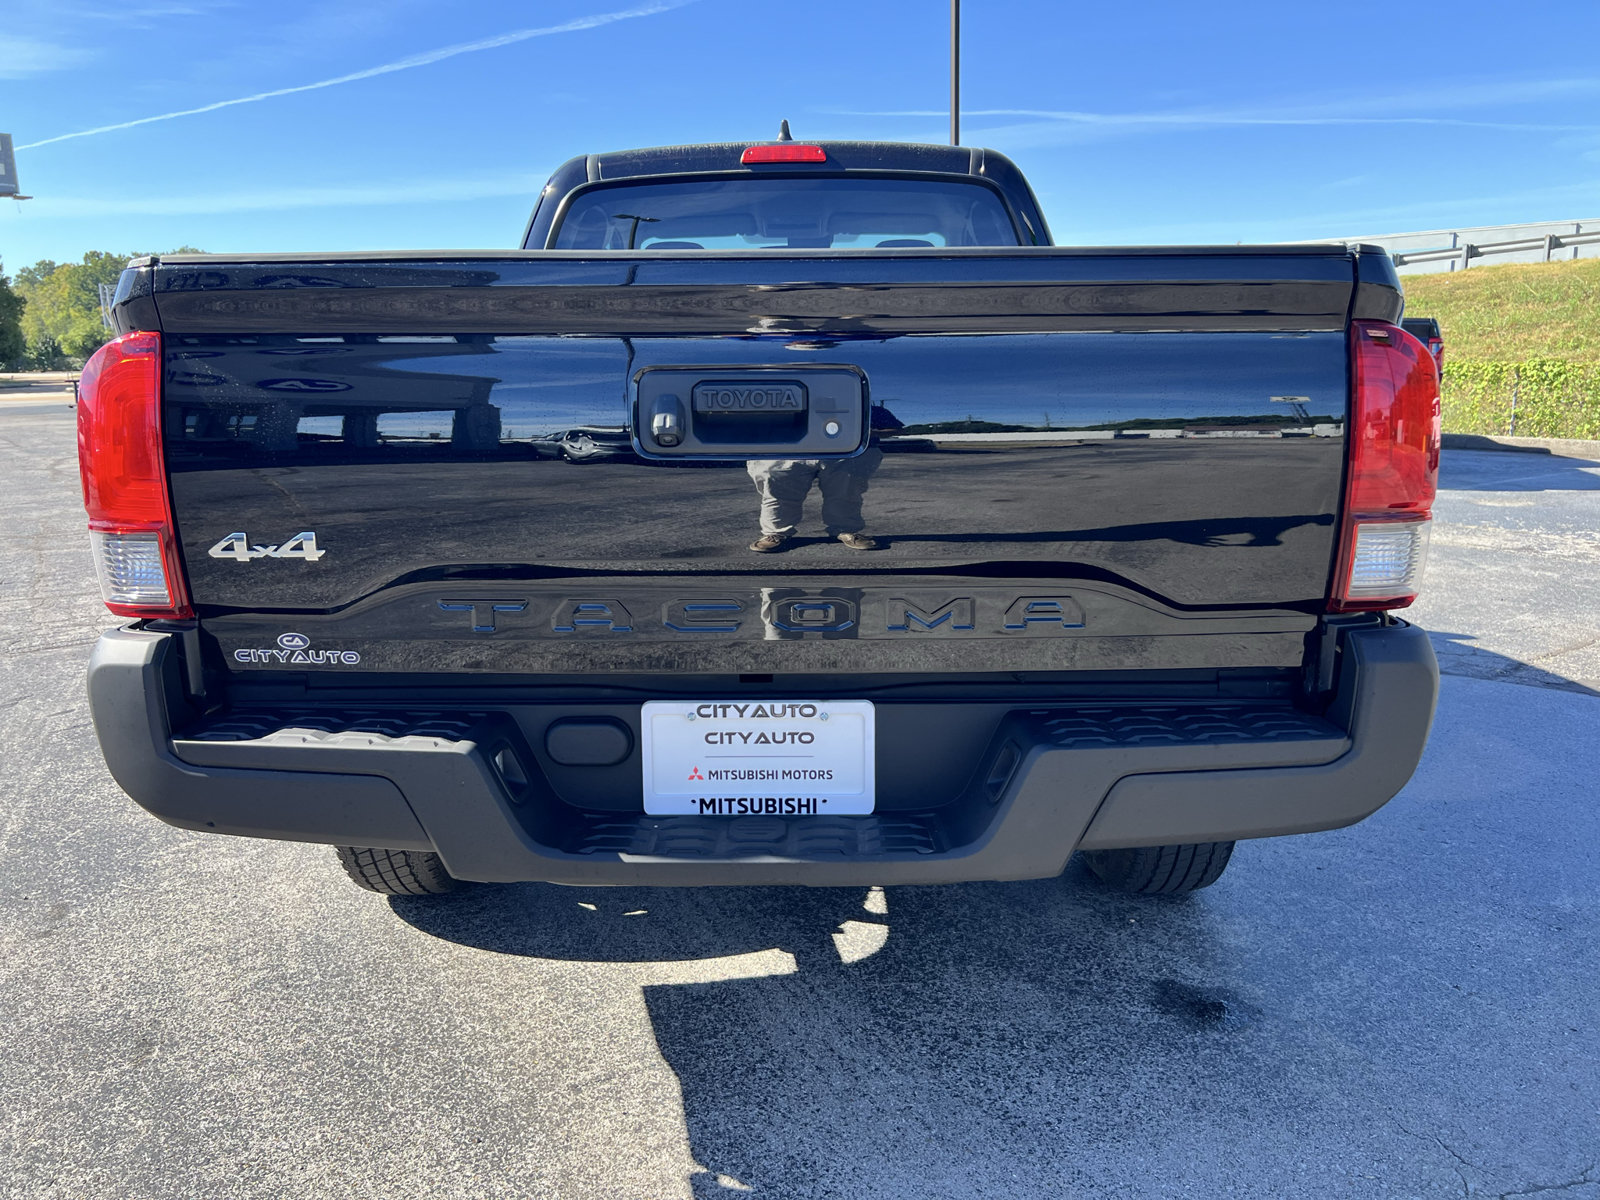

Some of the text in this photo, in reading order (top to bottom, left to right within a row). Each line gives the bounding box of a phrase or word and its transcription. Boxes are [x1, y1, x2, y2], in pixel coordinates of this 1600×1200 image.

[701, 388, 798, 408] TOYOTA
[208, 532, 326, 562] 4x4
[437, 596, 1086, 632] TACOMA
[708, 769, 833, 781] MITSUBISHI MOTORS
[699, 797, 818, 814] MITSUBISHI
